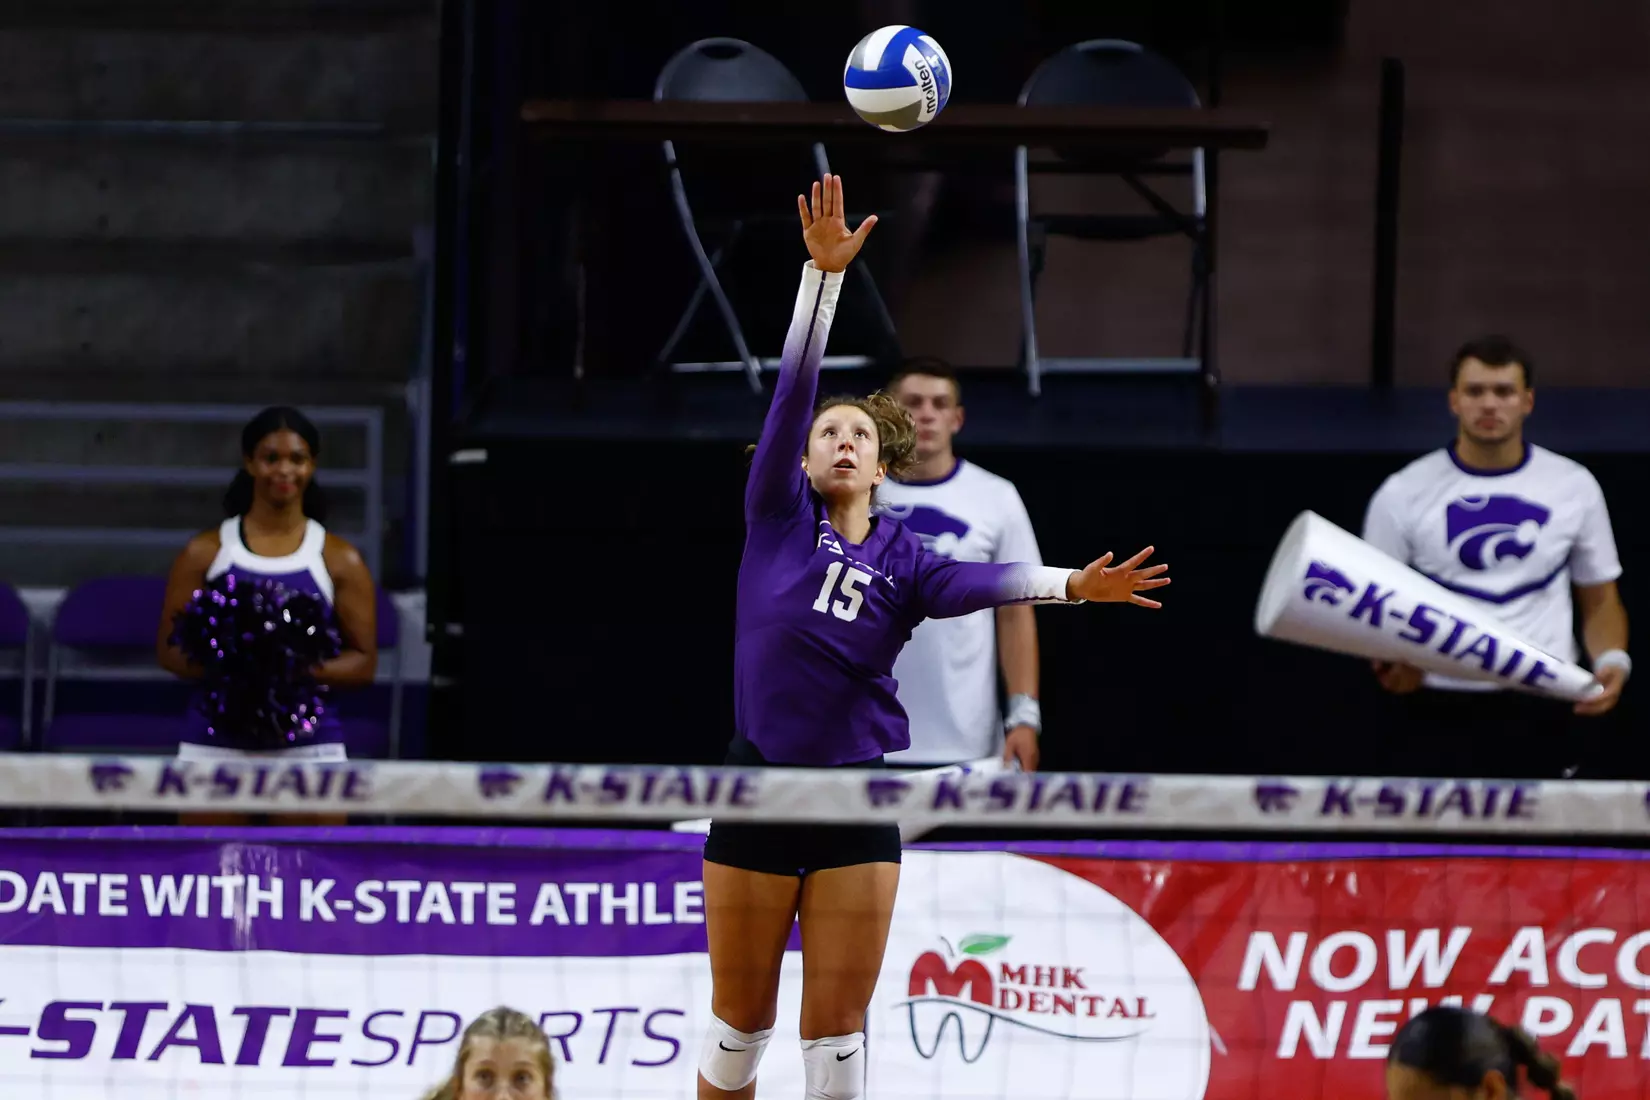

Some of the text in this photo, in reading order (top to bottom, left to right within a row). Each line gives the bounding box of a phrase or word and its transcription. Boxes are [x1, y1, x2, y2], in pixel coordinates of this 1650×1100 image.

[913, 59, 937, 114] molten
[812, 561, 873, 622] 15
[155, 762, 375, 800] K-STATE
[545, 766, 759, 807] K-STATE
[930, 773, 1148, 813] K-STATE
[1319, 778, 1540, 819] K-STATE
[0, 870, 705, 925] DATE WITH K-STATE ATHLE
[1000, 962, 1087, 990] MHK
[1237, 926, 1472, 992] NOW
[1000, 987, 1157, 1018] DENTAL
[1276, 995, 1494, 1059] NE
